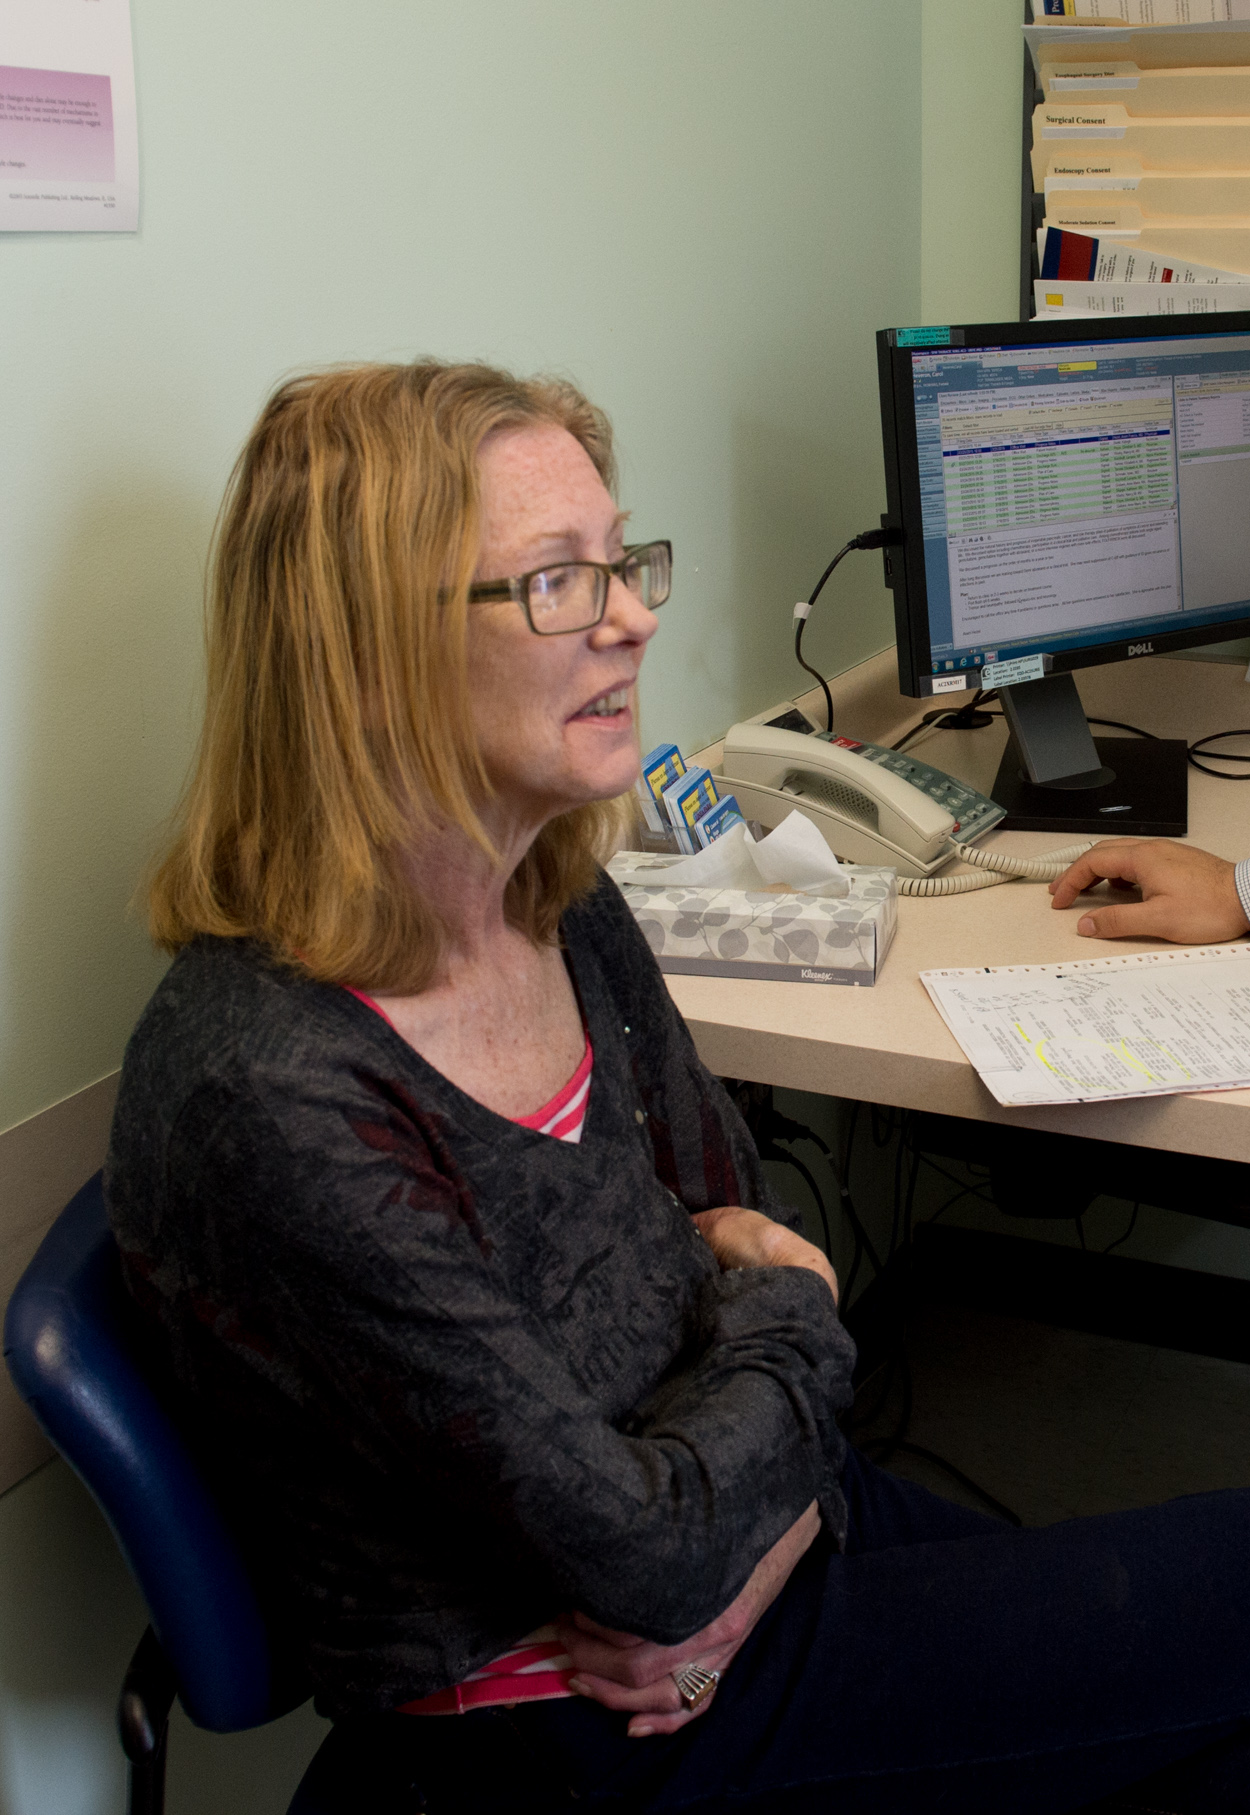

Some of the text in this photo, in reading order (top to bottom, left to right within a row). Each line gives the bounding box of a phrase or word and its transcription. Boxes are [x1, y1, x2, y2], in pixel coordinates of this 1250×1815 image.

[1046, 116, 1074, 125] Surgical
[1054, 167, 1084, 175] Endoscopy
[1128, 643, 1154, 656] DELL
[801, 969, 832, 981] Kleenex
